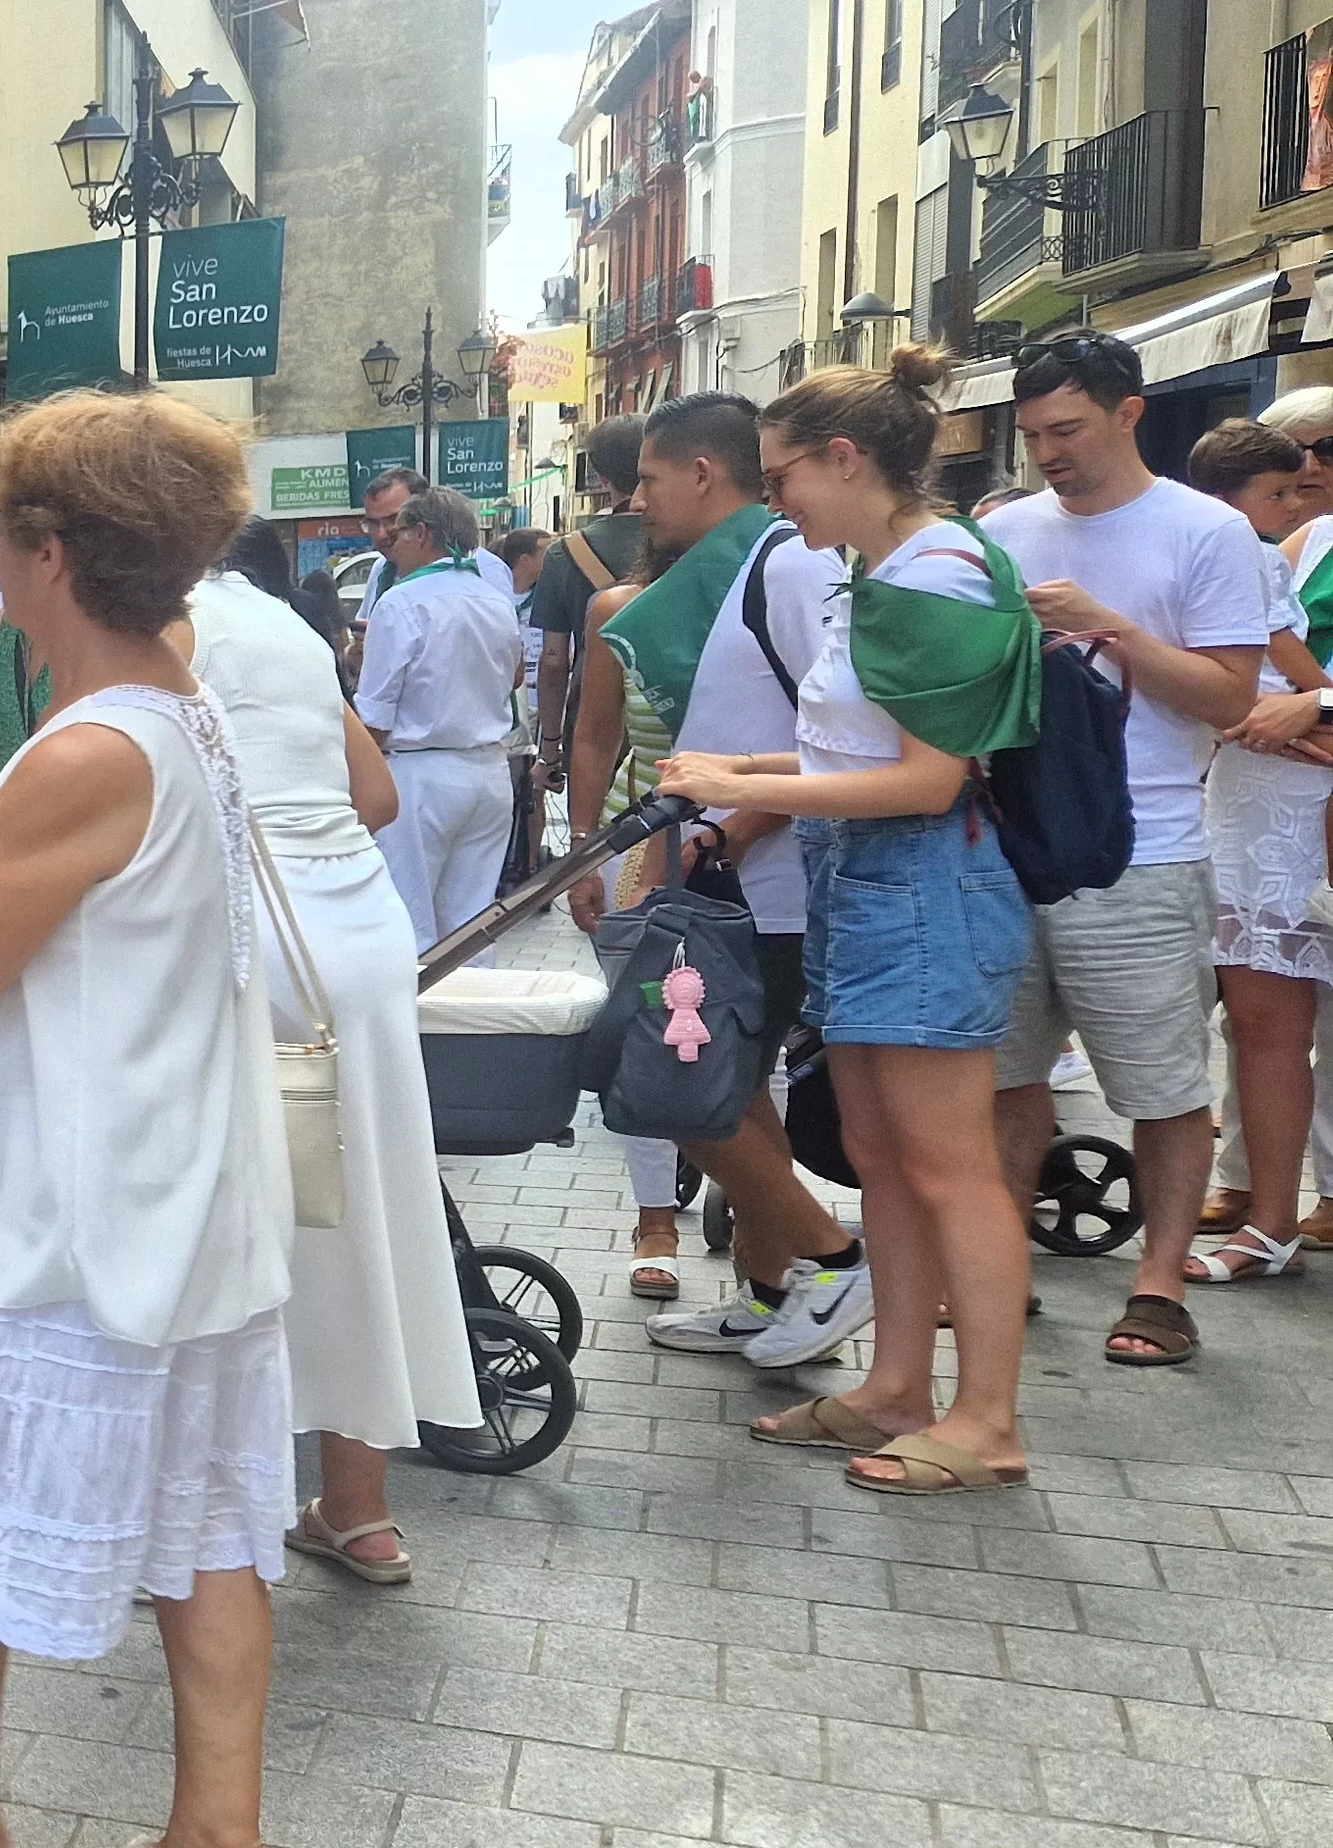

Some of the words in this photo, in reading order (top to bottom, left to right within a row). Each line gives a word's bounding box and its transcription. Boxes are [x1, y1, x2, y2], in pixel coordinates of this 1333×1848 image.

[172, 255, 219, 279] vive
[170, 280, 217, 304] San
[45, 299, 109, 317] Ayuntamiento
[45, 316, 56, 327] de
[58, 312, 94, 325] Huesca
[168, 303, 269, 330] Lorenzo
[166, 347, 198, 358] fiestas
[199, 345, 212, 356] de
[177, 358, 213, 369] Huesca
[447, 436, 475, 447] vive
[447, 447, 475, 461] San
[447, 460, 504, 475] Lorenzo
[276, 492, 321, 502] BEBIDAS
